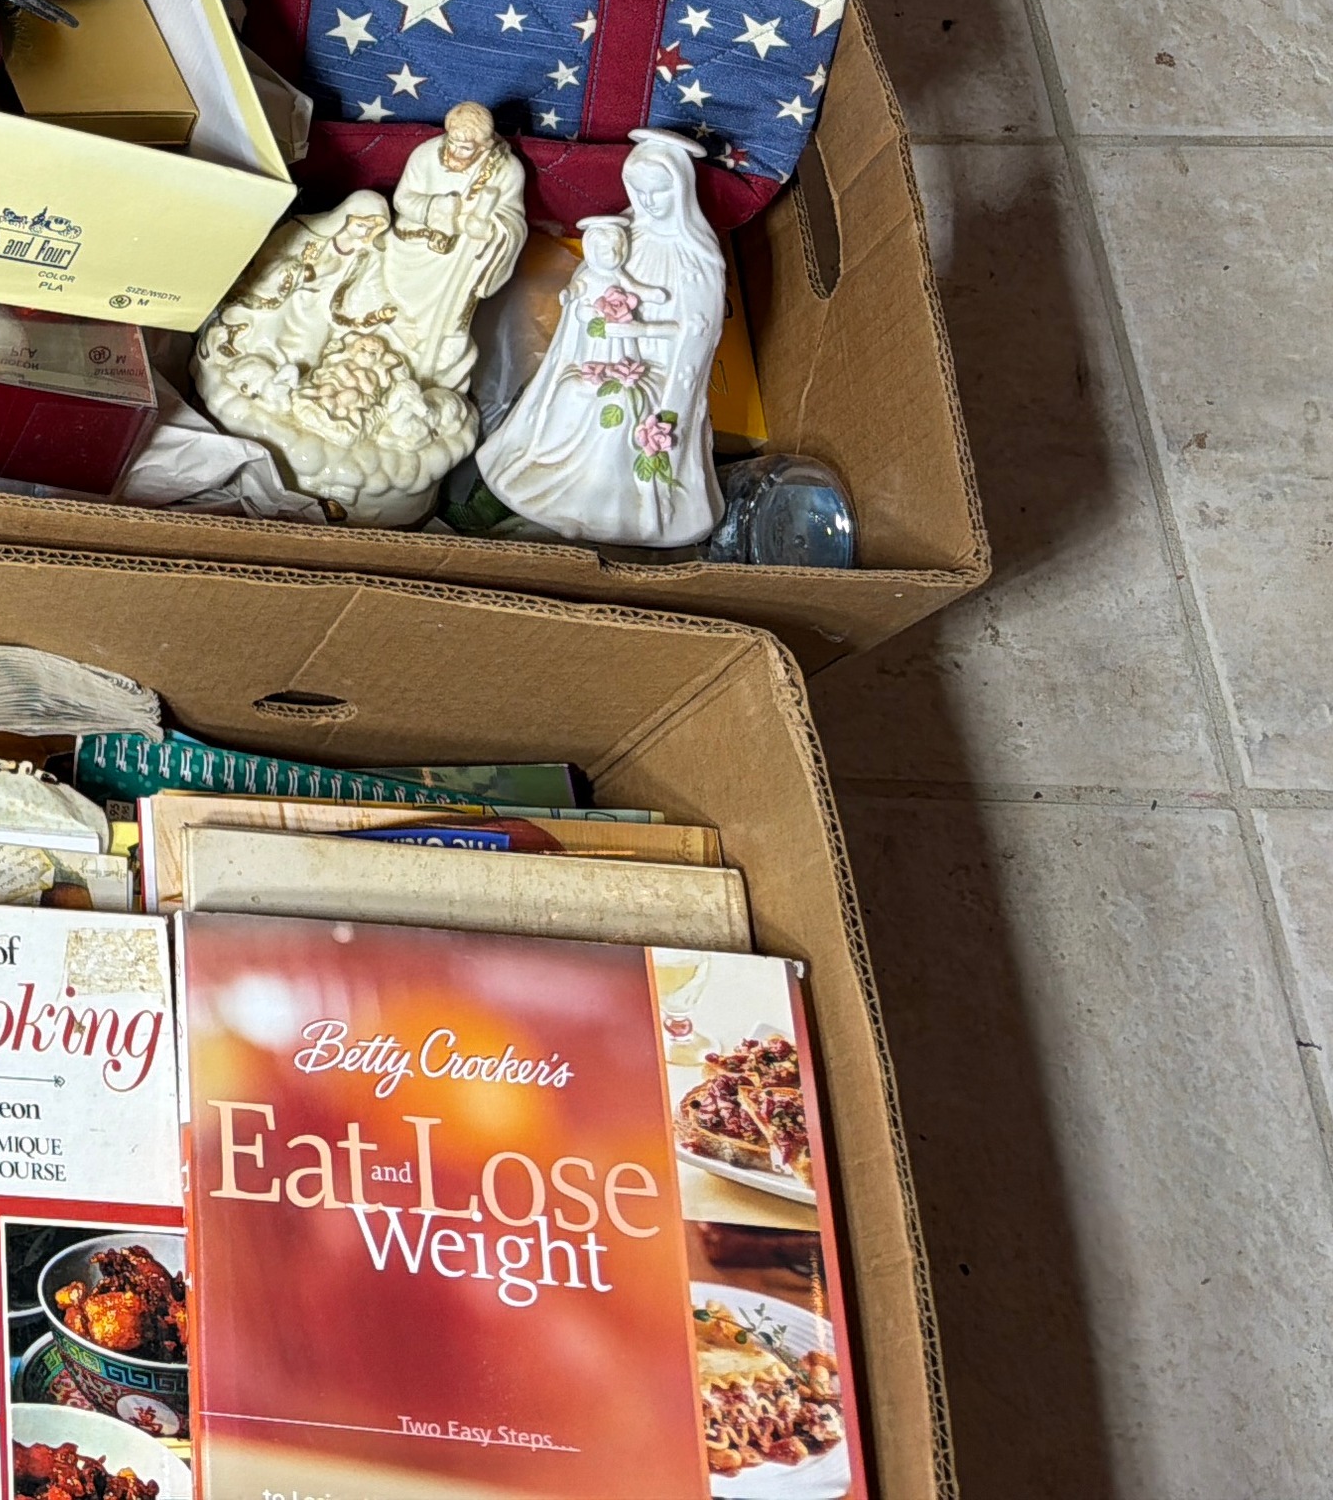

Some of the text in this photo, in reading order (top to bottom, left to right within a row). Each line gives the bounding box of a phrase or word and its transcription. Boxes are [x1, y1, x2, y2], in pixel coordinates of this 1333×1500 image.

[4, 233, 33, 259] and
[35, 239, 72, 265] Four
[38, 270, 76, 284] COLOR
[38, 280, 64, 294] PLA
[292, 1017, 576, 1100] Betty Crocker's
[206, 1098, 661, 1241] Eat and Lose
[351, 1202, 615, 1307] Weight
[398, 1415, 493, 1448] Two Easy
